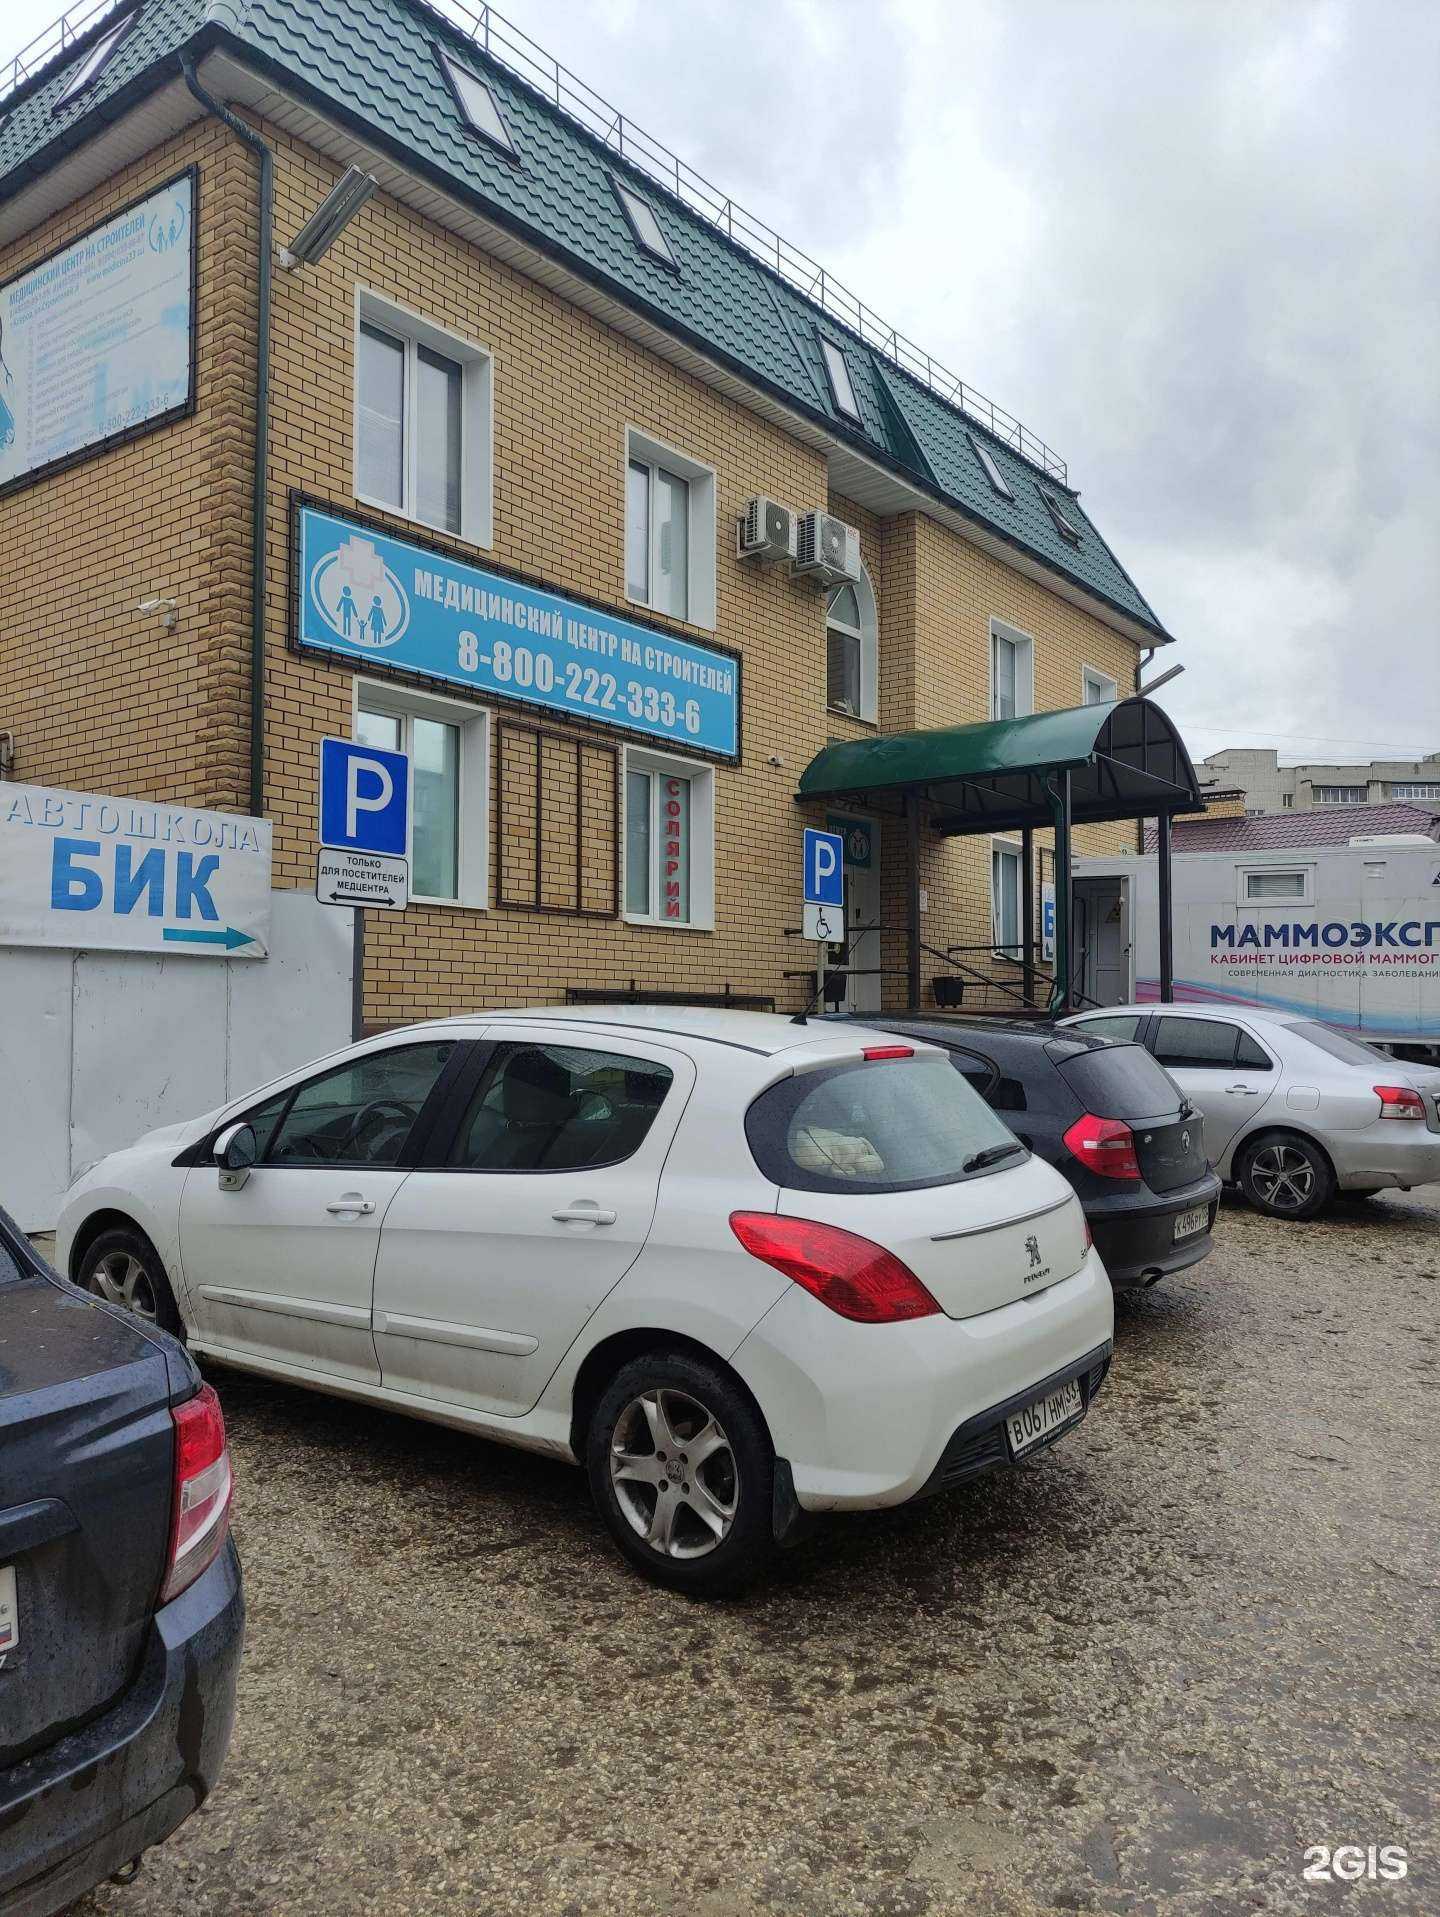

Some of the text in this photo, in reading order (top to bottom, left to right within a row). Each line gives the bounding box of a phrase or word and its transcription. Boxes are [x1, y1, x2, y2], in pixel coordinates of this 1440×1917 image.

[61, 250, 84, 275] ЦЕНТР
[85, 242, 96, 261] НА
[414, 567, 732, 696] МЕДИЦИНСКИЙ ЦЕНТР НА СТРОИТЕЛЕЙ
[458, 630, 700, 735] 8-800-222-333-6
[6, 794, 261, 853] АВТОШКОЛА
[346, 755, 394, 838] P
[320, 866, 405, 884] ДЛЯ ПОСЕТИТЕЛЕЙ
[346, 856, 382, 869] ТОЛЬКО
[664, 779, 682, 919] СОЛЯРИЙ
[815, 839, 836, 895] P
[51, 837, 220, 921] БИК
[337, 880, 390, 895] МЕДЦЕНТРА
[1210, 951, 1440, 965] КАБИНЕТ ЦИФРОВОЙ МАММОГ
[1228, 969, 1294, 978] СОВРЕМЕННАЯ
[1297, 970, 1368, 978] ДИАГНОСТИКА
